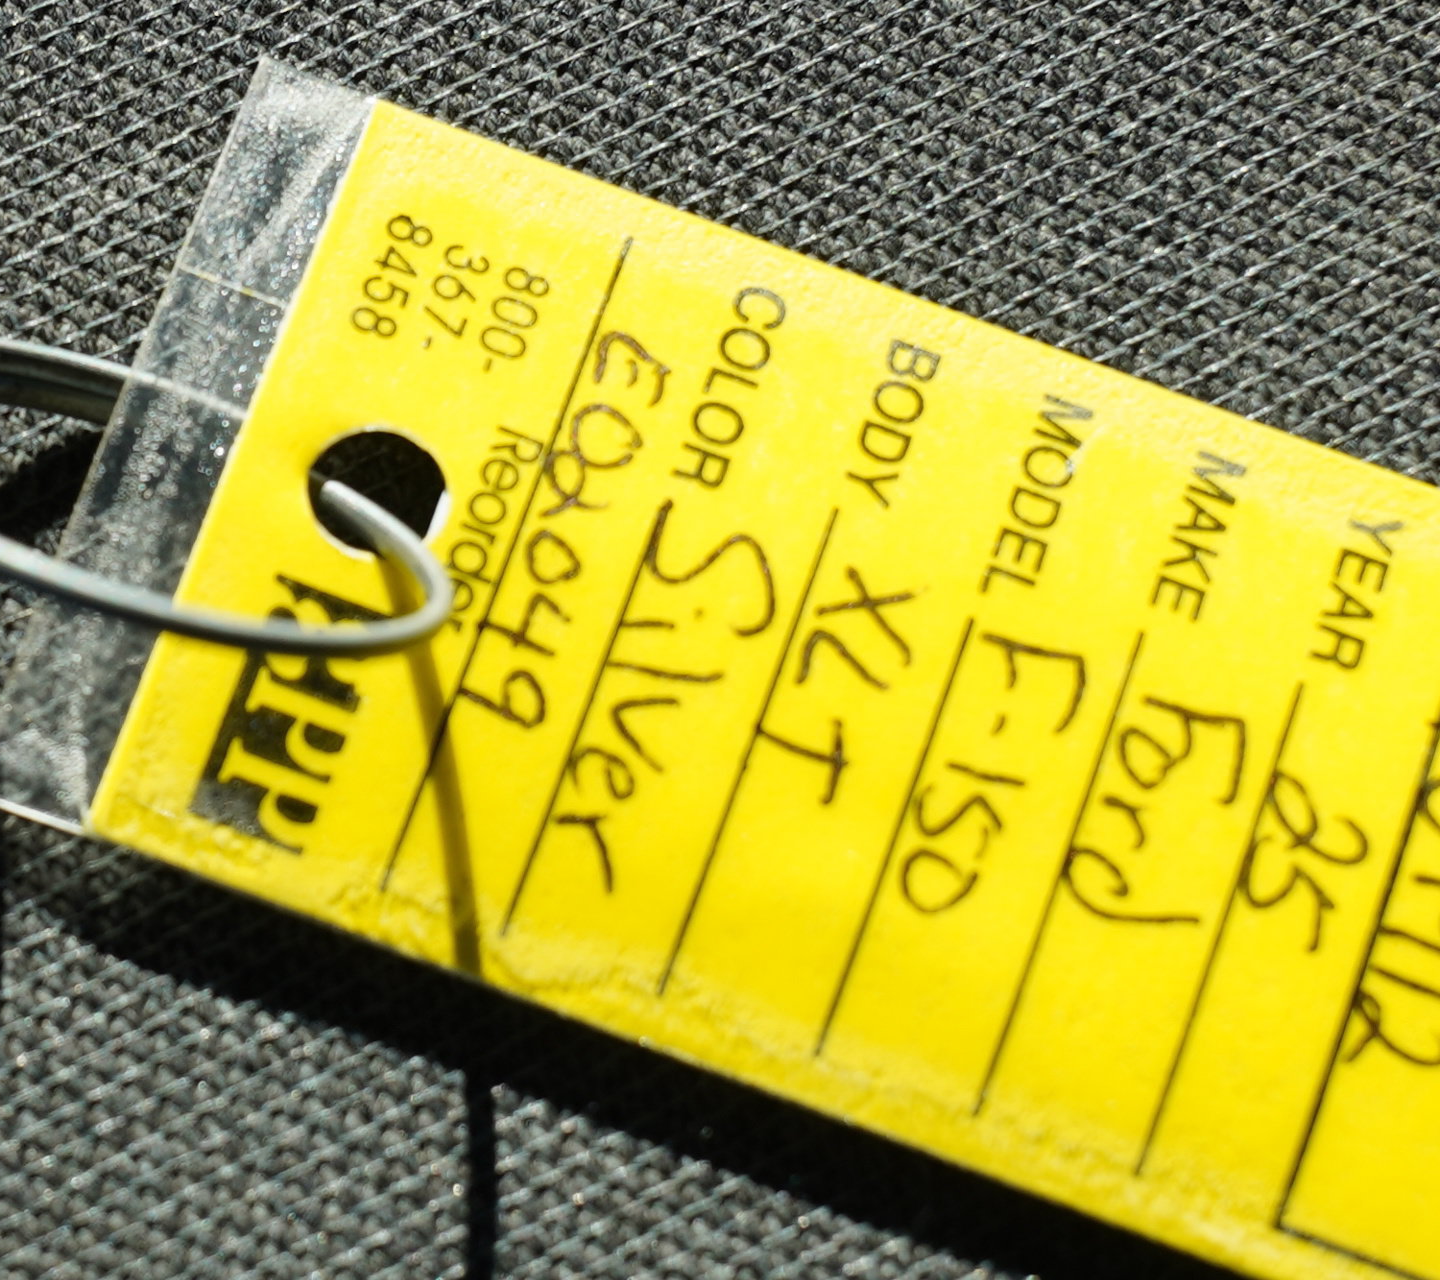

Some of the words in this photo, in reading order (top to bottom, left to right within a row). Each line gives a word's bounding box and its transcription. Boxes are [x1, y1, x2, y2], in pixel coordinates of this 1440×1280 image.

[351, 213, 433, 338] 8458
[427, 244, 490, 351] 367-
[481, 266, 550, 372] 800-
[673, 287, 787, 489] COLOR
[847, 339, 941, 507] BODY
[982, 394, 1093, 595] MODEL
[1151, 452, 1247, 622] MAKE
[1310, 518, 1403, 670] YEAR
[554, 500, 776, 894] Silver
[755, 565, 914, 806] XLT
[900, 634, 1087, 913] F-150
[1061, 697, 1247, 924] Ford
[1242, 772, 1370, 953] 25
